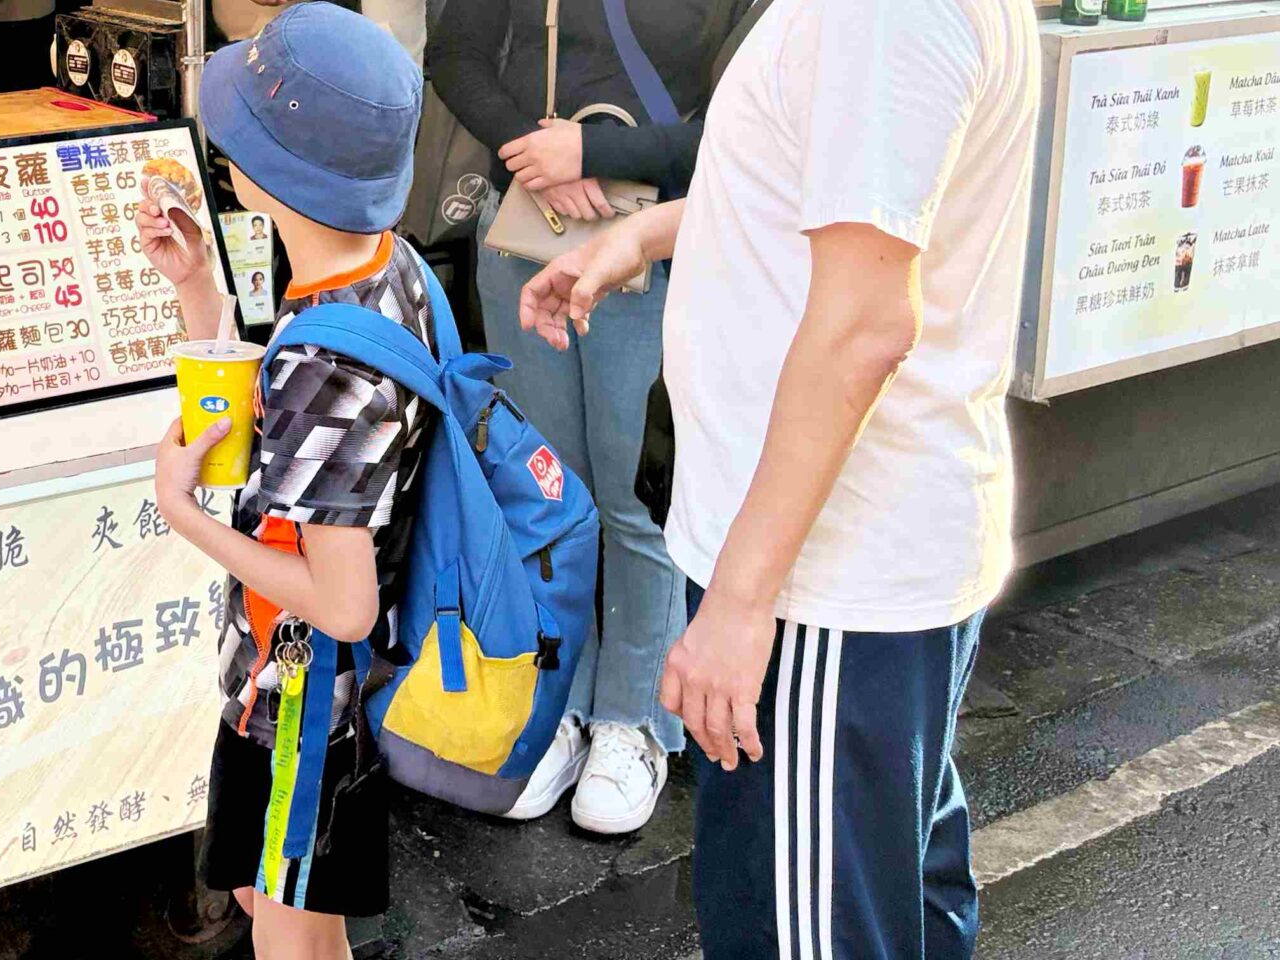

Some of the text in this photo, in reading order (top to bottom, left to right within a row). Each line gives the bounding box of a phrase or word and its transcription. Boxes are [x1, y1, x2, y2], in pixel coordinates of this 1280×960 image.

[1155, 86, 1180, 101] Xanh
[1229, 74, 1263, 90] Matcha
[1230, 95, 1278, 119] 草莓抹茶
[1106, 110, 1160, 136] 泰式奶綠
[56, 138, 153, 172] 雪糕菠蘿
[1219, 152, 1253, 169] Matcha
[70, 171, 137, 196] 香草 65
[1222, 172, 1270, 197] 芒果抹茶
[30, 196, 60, 220] 40
[78, 203, 120, 227] 芒果
[1097, 189, 1152, 216] 泰式奶茶
[1, 231, 11, 244] 3
[34, 220, 68, 245] 110
[86, 224, 121, 236] Mango
[1212, 223, 1270, 245] Matcha Latte
[85, 235, 126, 262] 芋頭
[48, 255, 76, 281] 50
[93, 258, 122, 269] Taro
[1212, 249, 1261, 278] 抹茶拿鐵
[93, 267, 161, 294] 草莓 65
[55, 284, 83, 309] 45
[101, 299, 181, 329] 巧克力 65
[66, 318, 90, 339] 30
